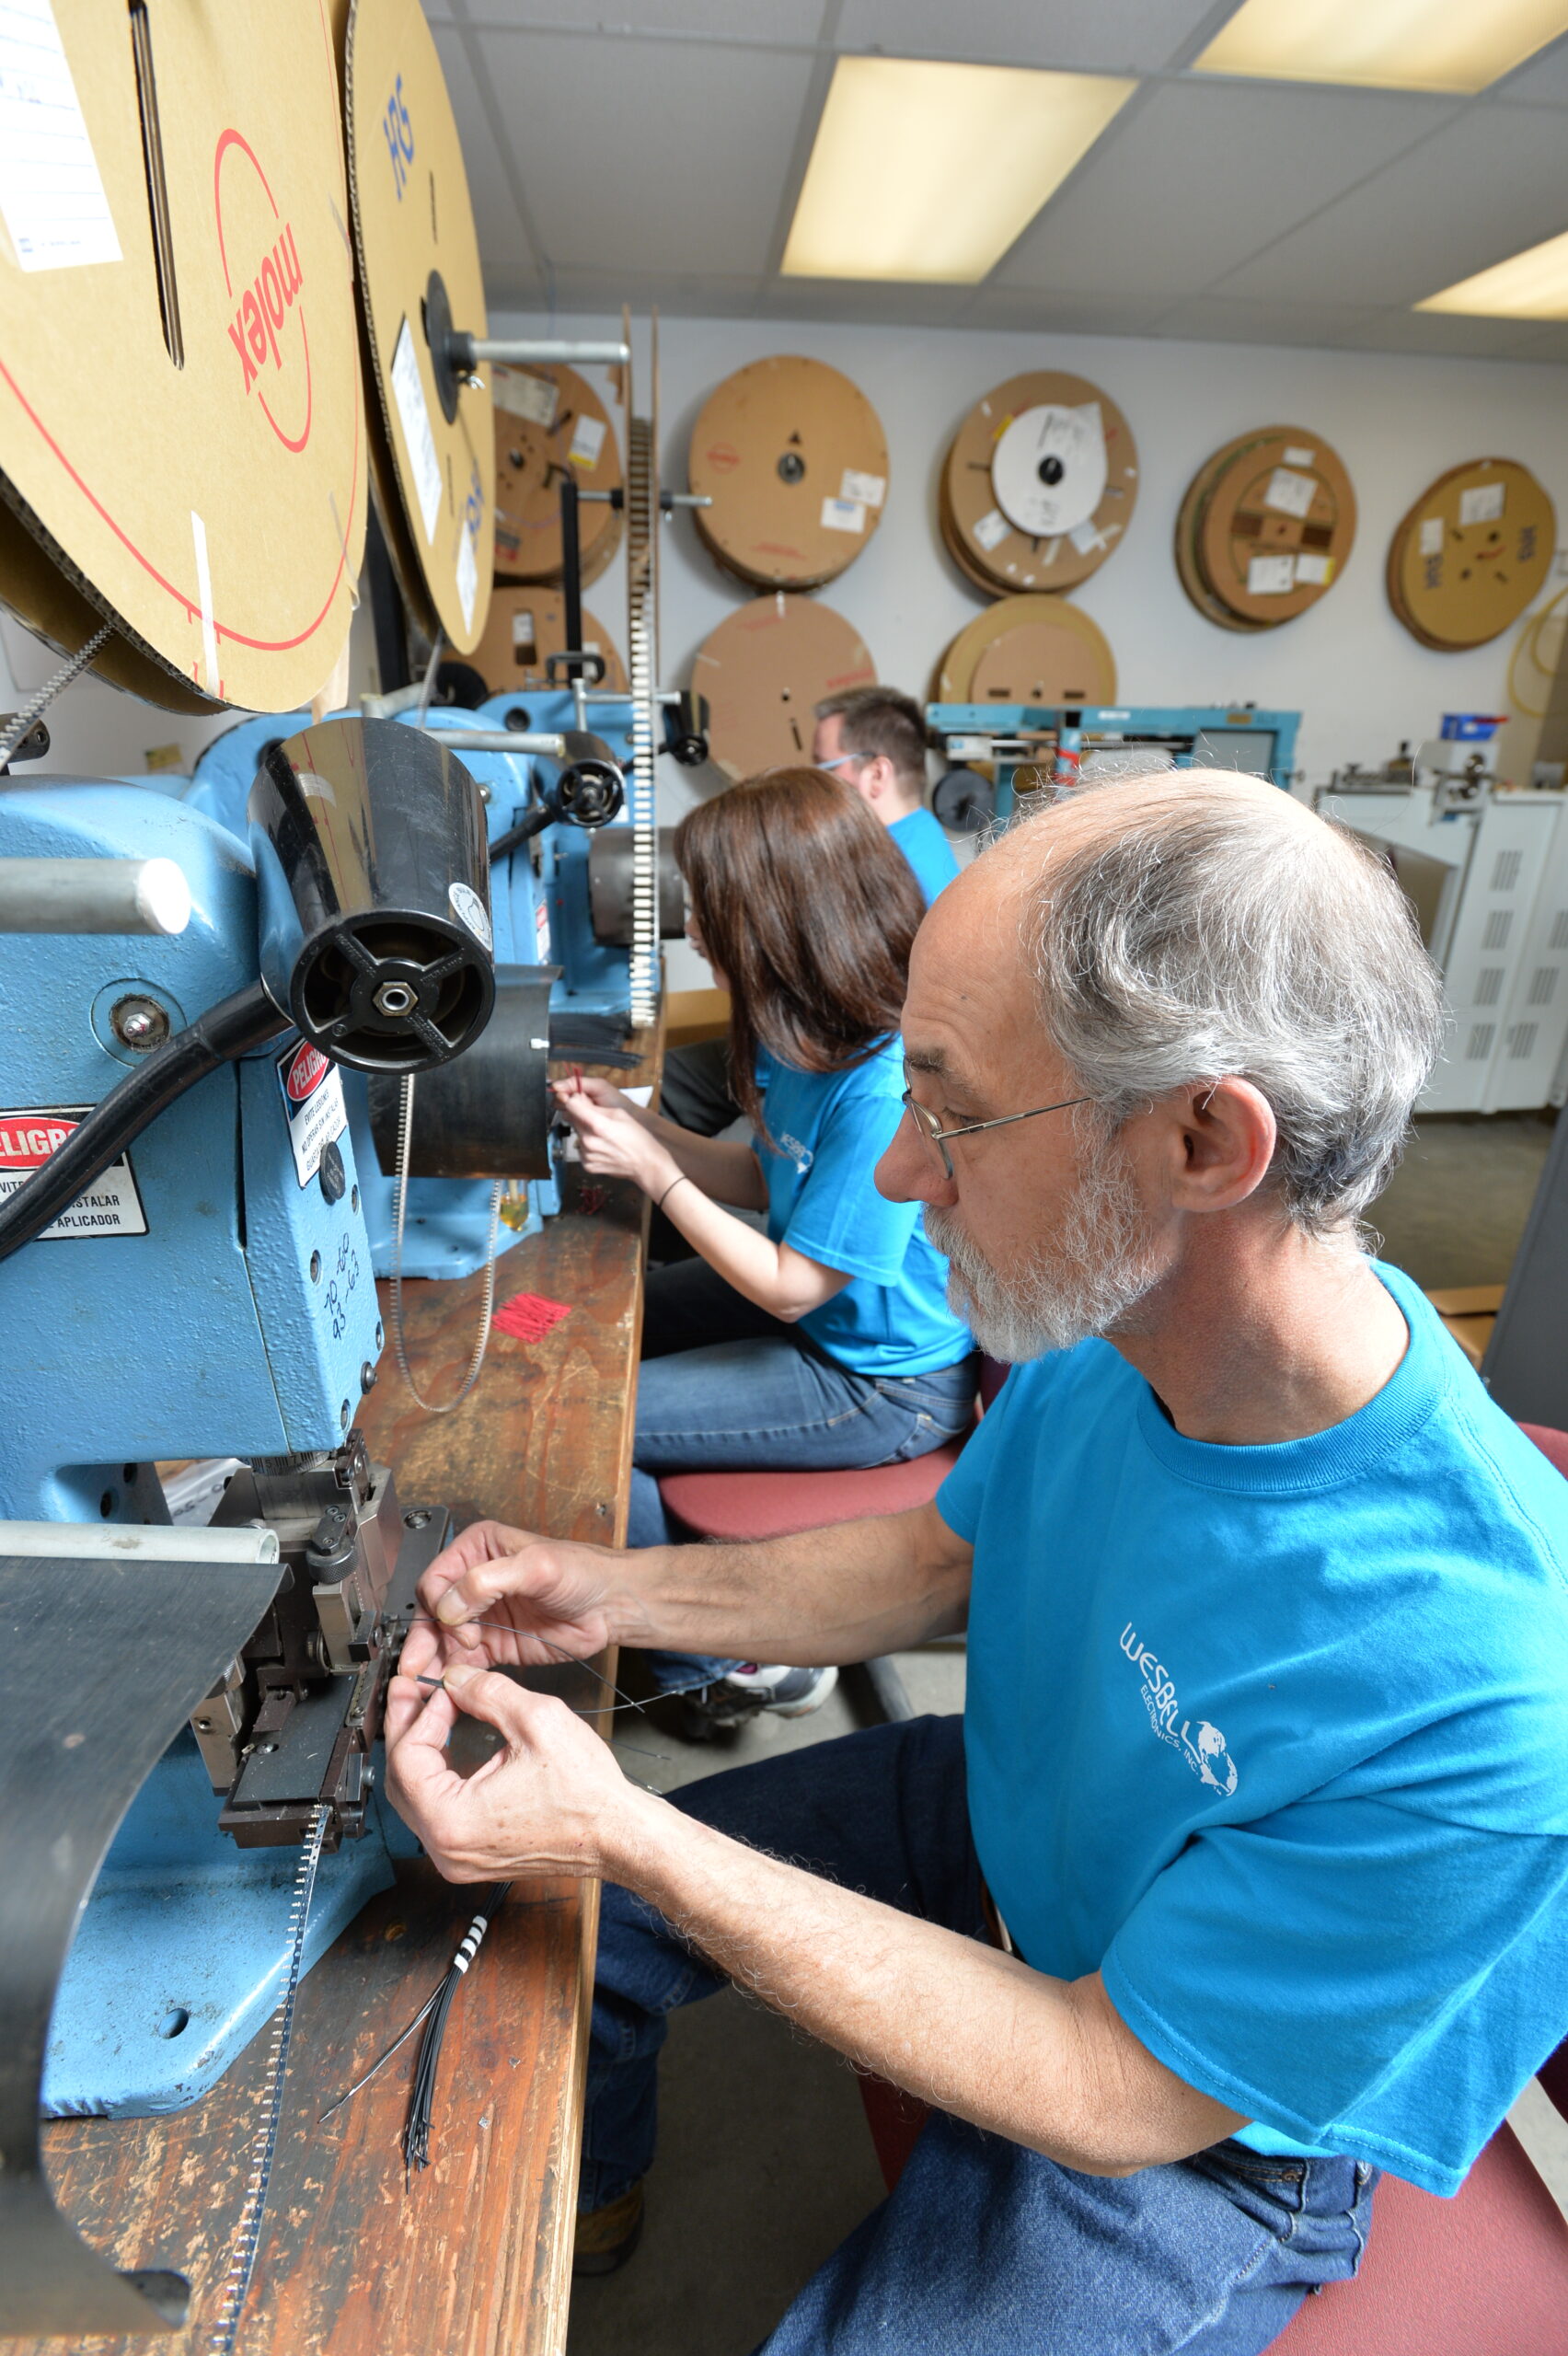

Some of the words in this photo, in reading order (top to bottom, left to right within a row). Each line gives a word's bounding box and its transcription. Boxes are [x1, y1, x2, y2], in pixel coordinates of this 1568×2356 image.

[227, 222, 304, 396] molex
[57, 1214, 121, 1229] APLICADOR
[1120, 1622, 1202, 1764] WESBELL
